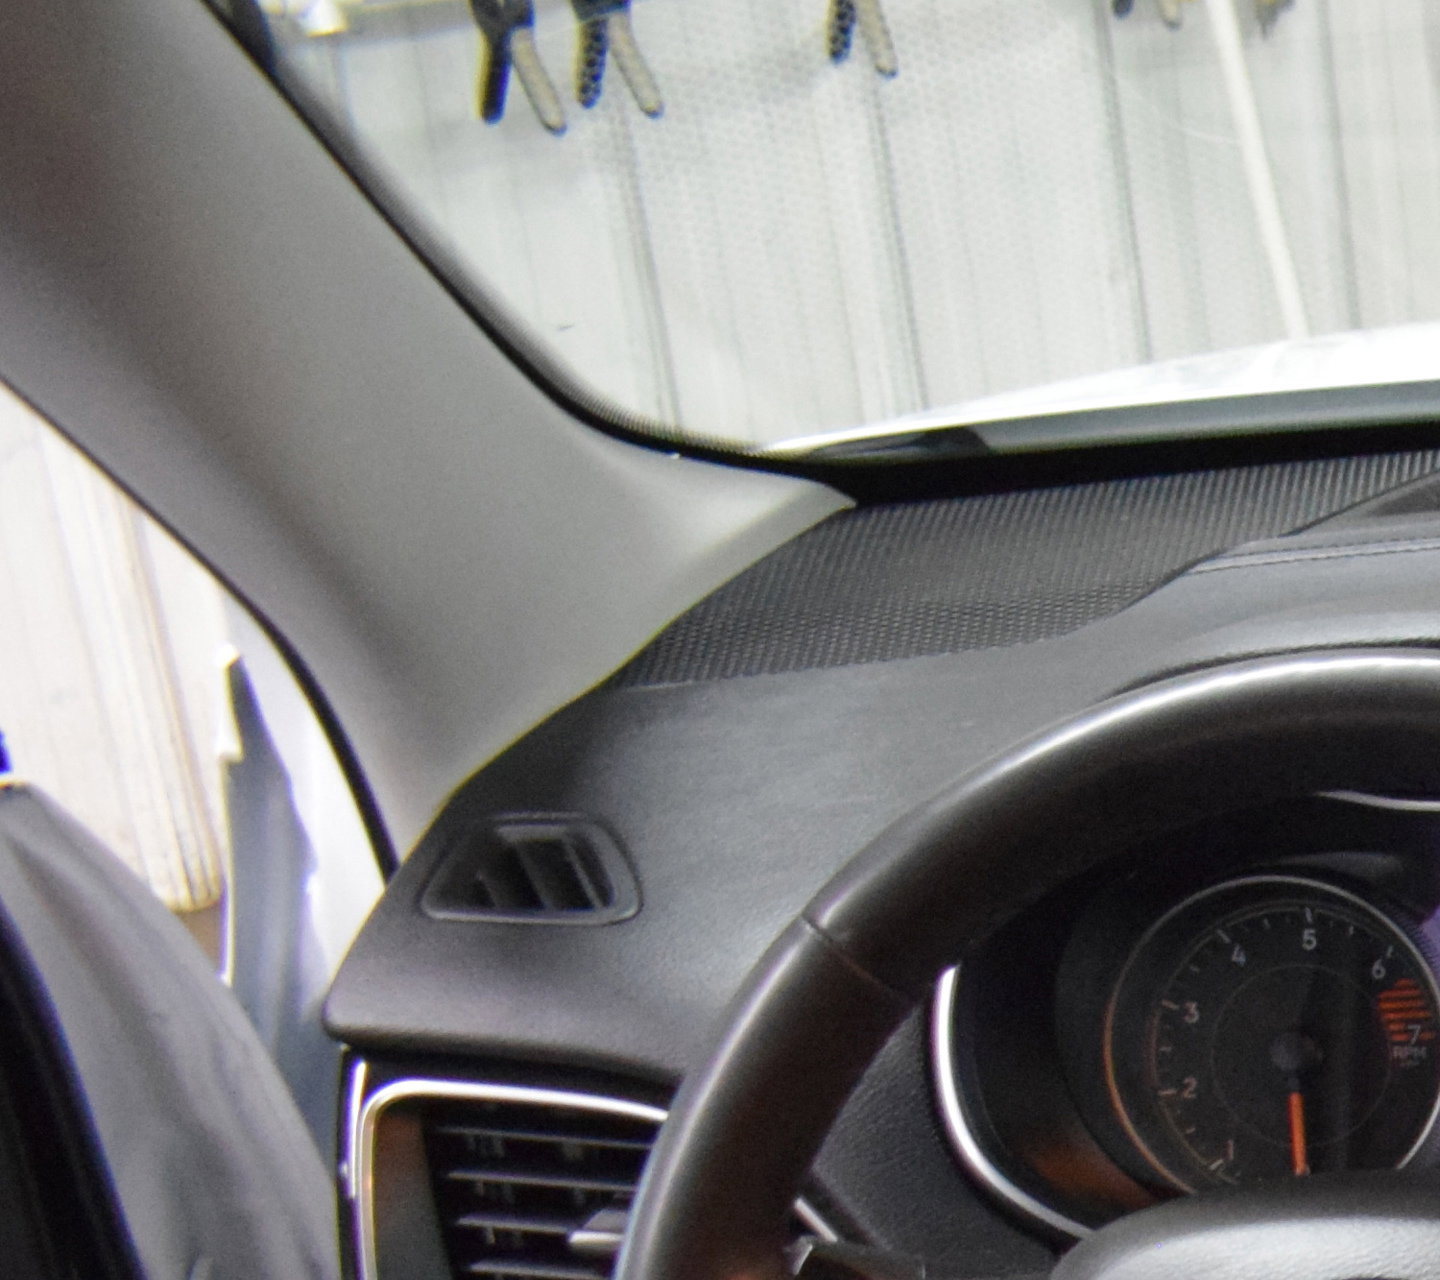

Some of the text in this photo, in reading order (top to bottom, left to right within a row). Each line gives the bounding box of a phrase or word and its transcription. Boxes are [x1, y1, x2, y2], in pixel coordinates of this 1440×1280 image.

[1301, 929, 1317, 951] 5
[1231, 944, 1246, 966] 4
[1371, 961, 1386, 980] 6
[1183, 1002, 1200, 1024] 3
[1407, 1024, 1421, 1044] 7
[1183, 1077, 1198, 1098] 2
